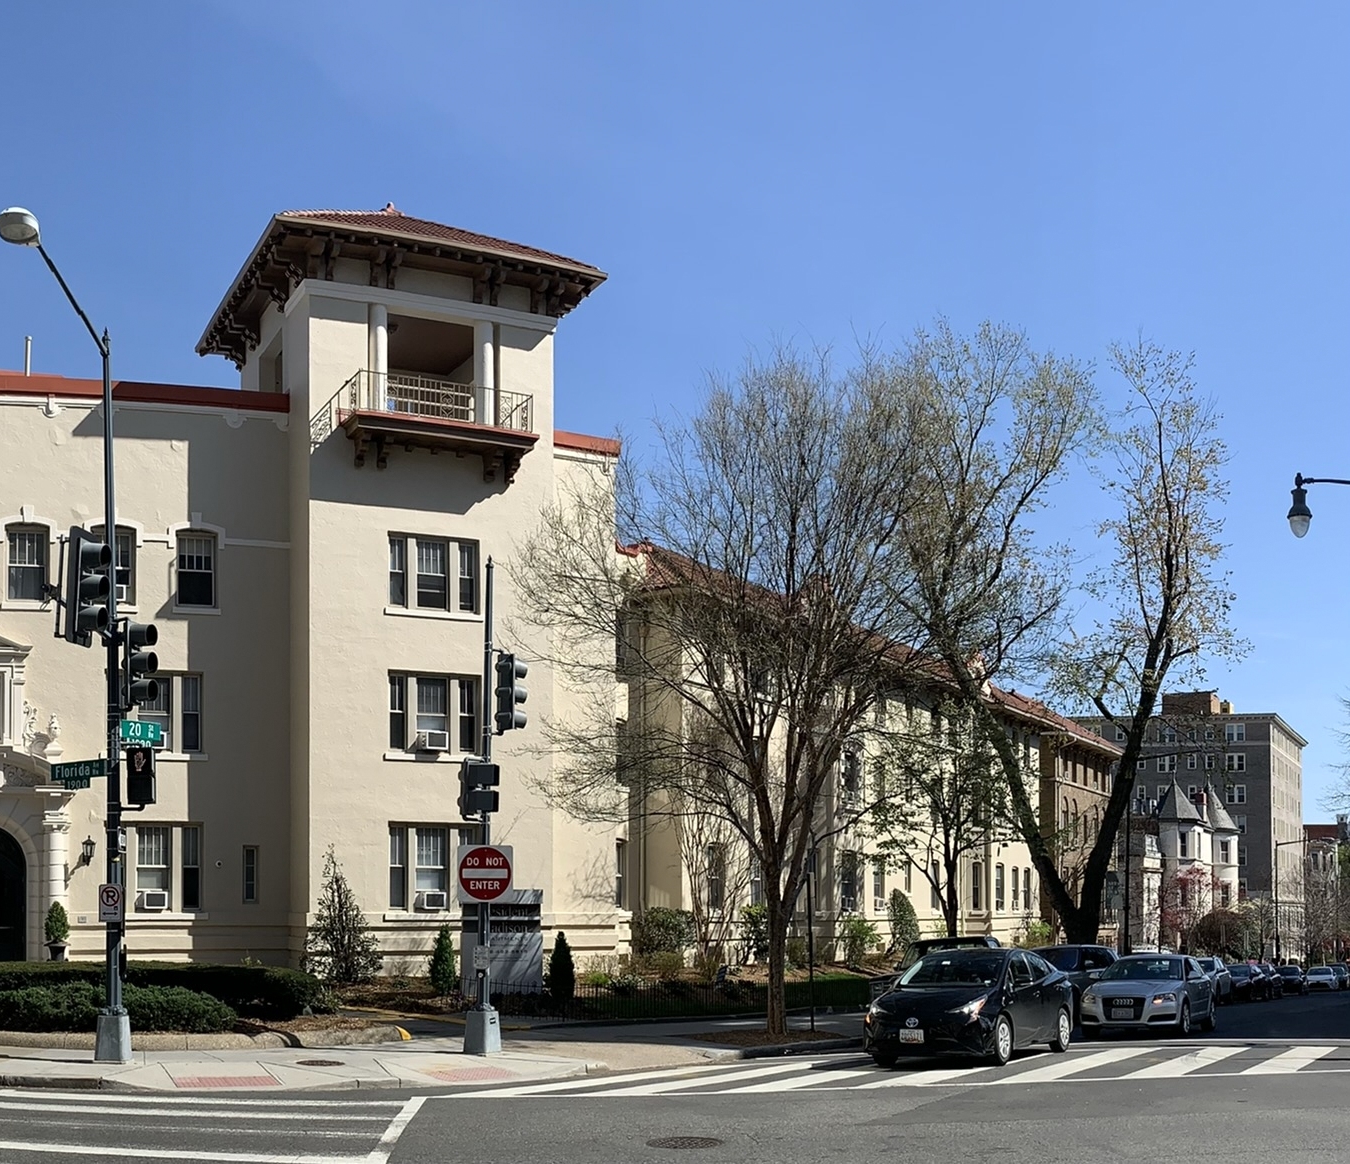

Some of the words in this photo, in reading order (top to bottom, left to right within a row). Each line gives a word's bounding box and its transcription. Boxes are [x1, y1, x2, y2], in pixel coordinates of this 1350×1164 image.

[129, 722, 141, 736] 20
[55, 763, 90, 778] Florida
[67, 779, 87, 788] 1900
[466, 857, 479, 866] DO
[486, 857, 504, 866] NOT
[470, 881, 500, 890] ENTER
[491, 922, 528, 933] adison
